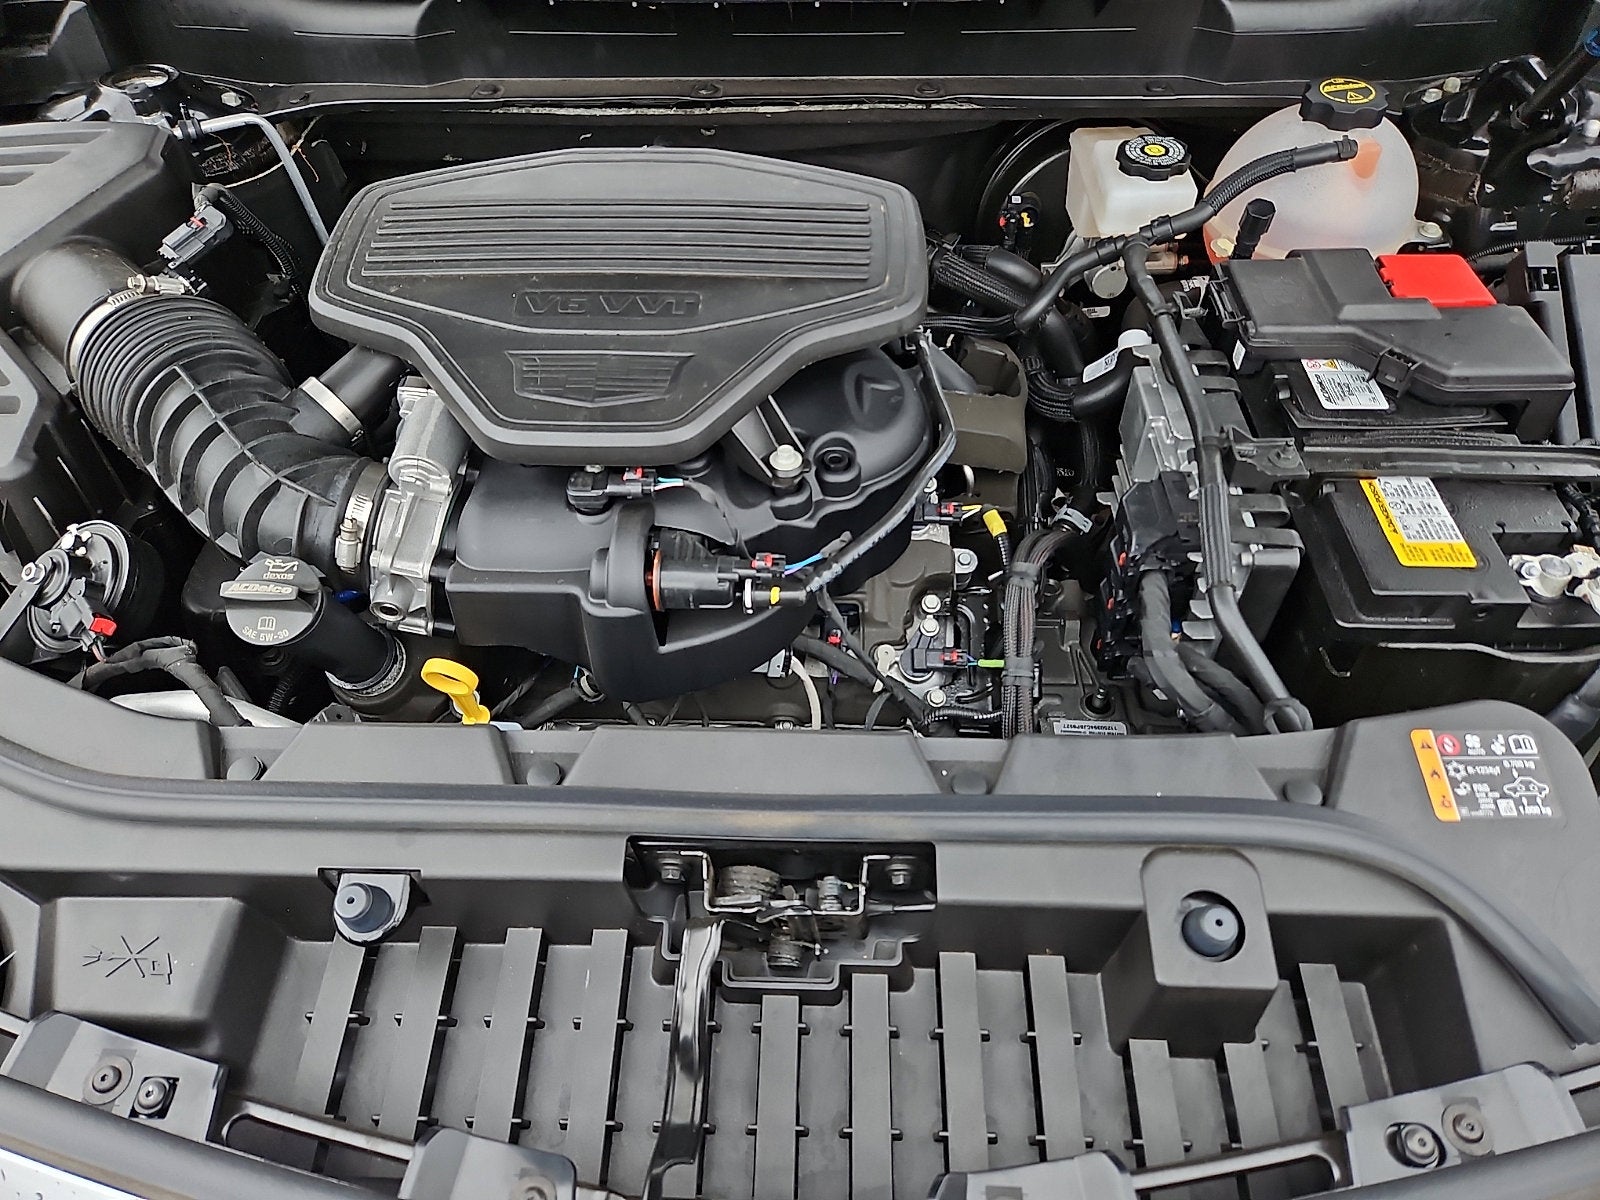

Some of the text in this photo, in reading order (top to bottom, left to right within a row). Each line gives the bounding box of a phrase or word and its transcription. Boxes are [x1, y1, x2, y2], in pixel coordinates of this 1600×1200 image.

[525, 296, 695, 314] V6 VVT
[263, 572, 295, 580] dexos
[226, 583, 292, 594] ACDelco
[242, 626, 289, 642] SAE 5W-30
